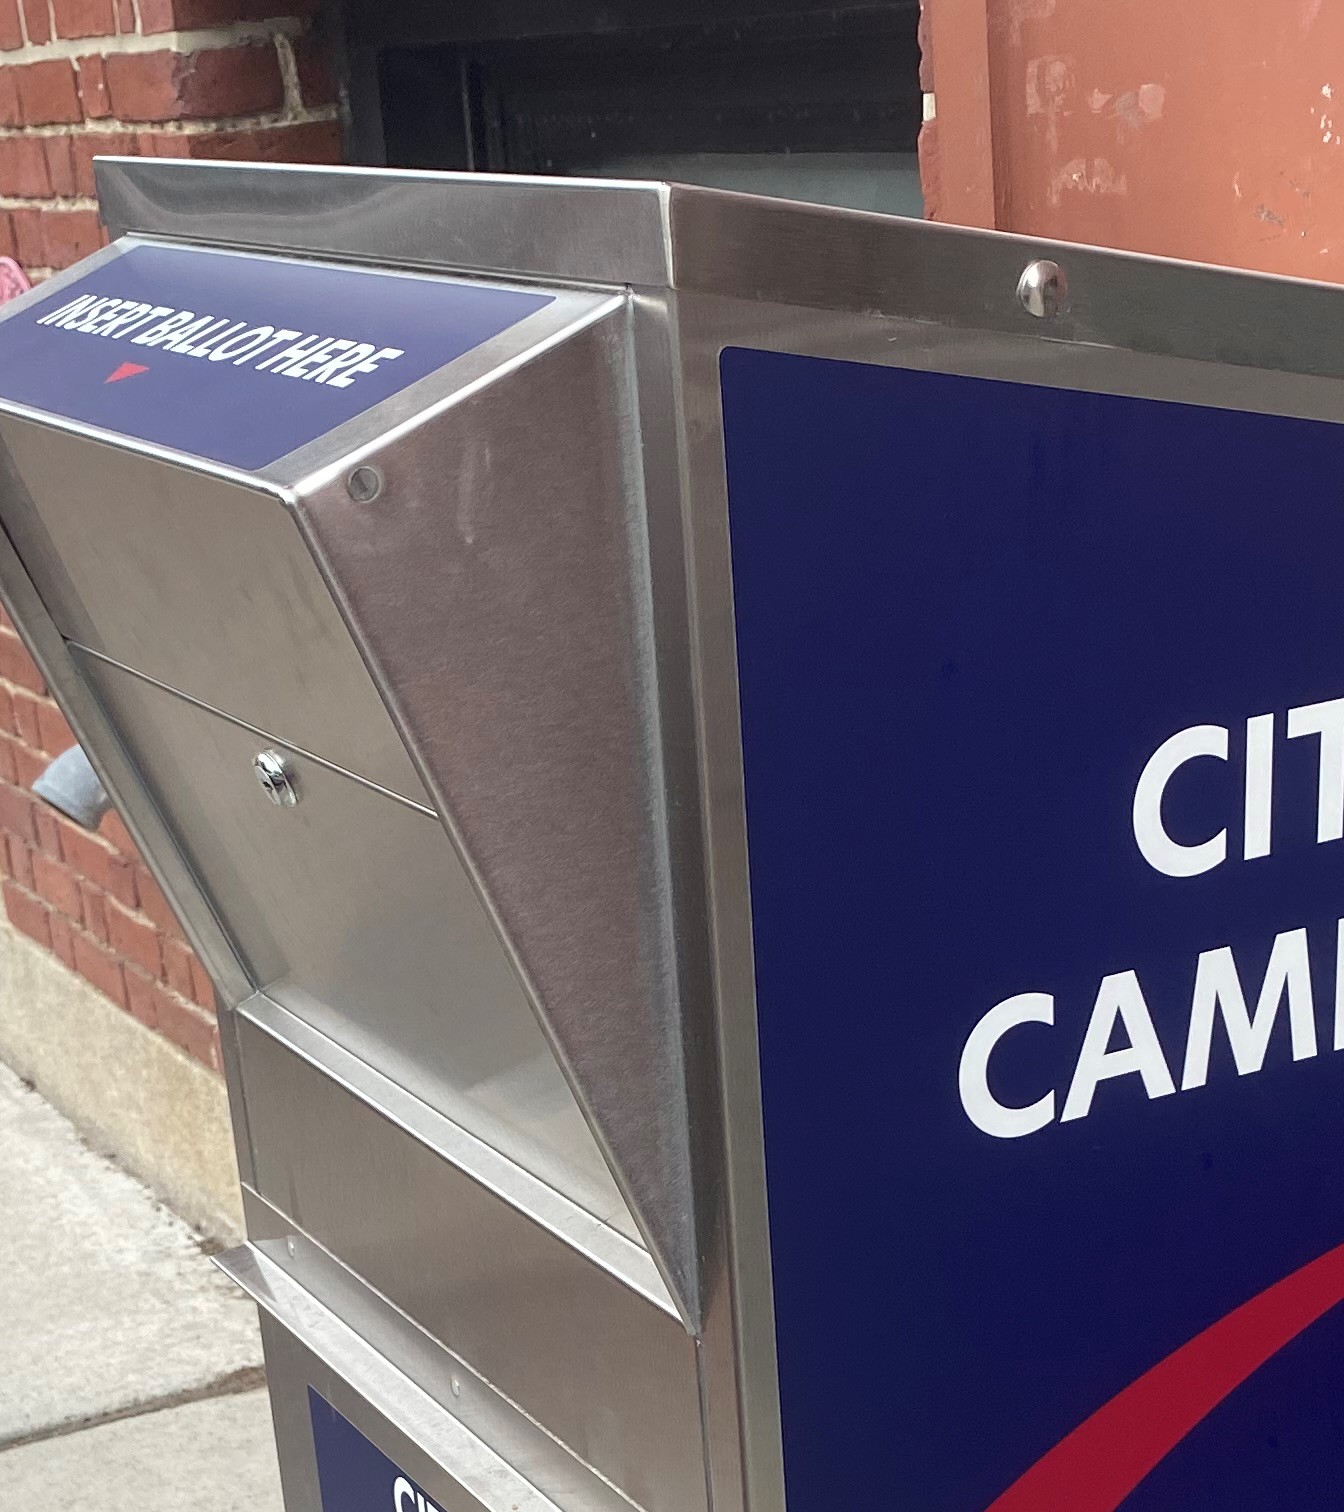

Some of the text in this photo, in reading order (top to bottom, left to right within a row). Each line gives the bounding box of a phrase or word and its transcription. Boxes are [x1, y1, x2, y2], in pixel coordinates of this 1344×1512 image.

[36, 294, 405, 388] INSERT BALLOT HERE
